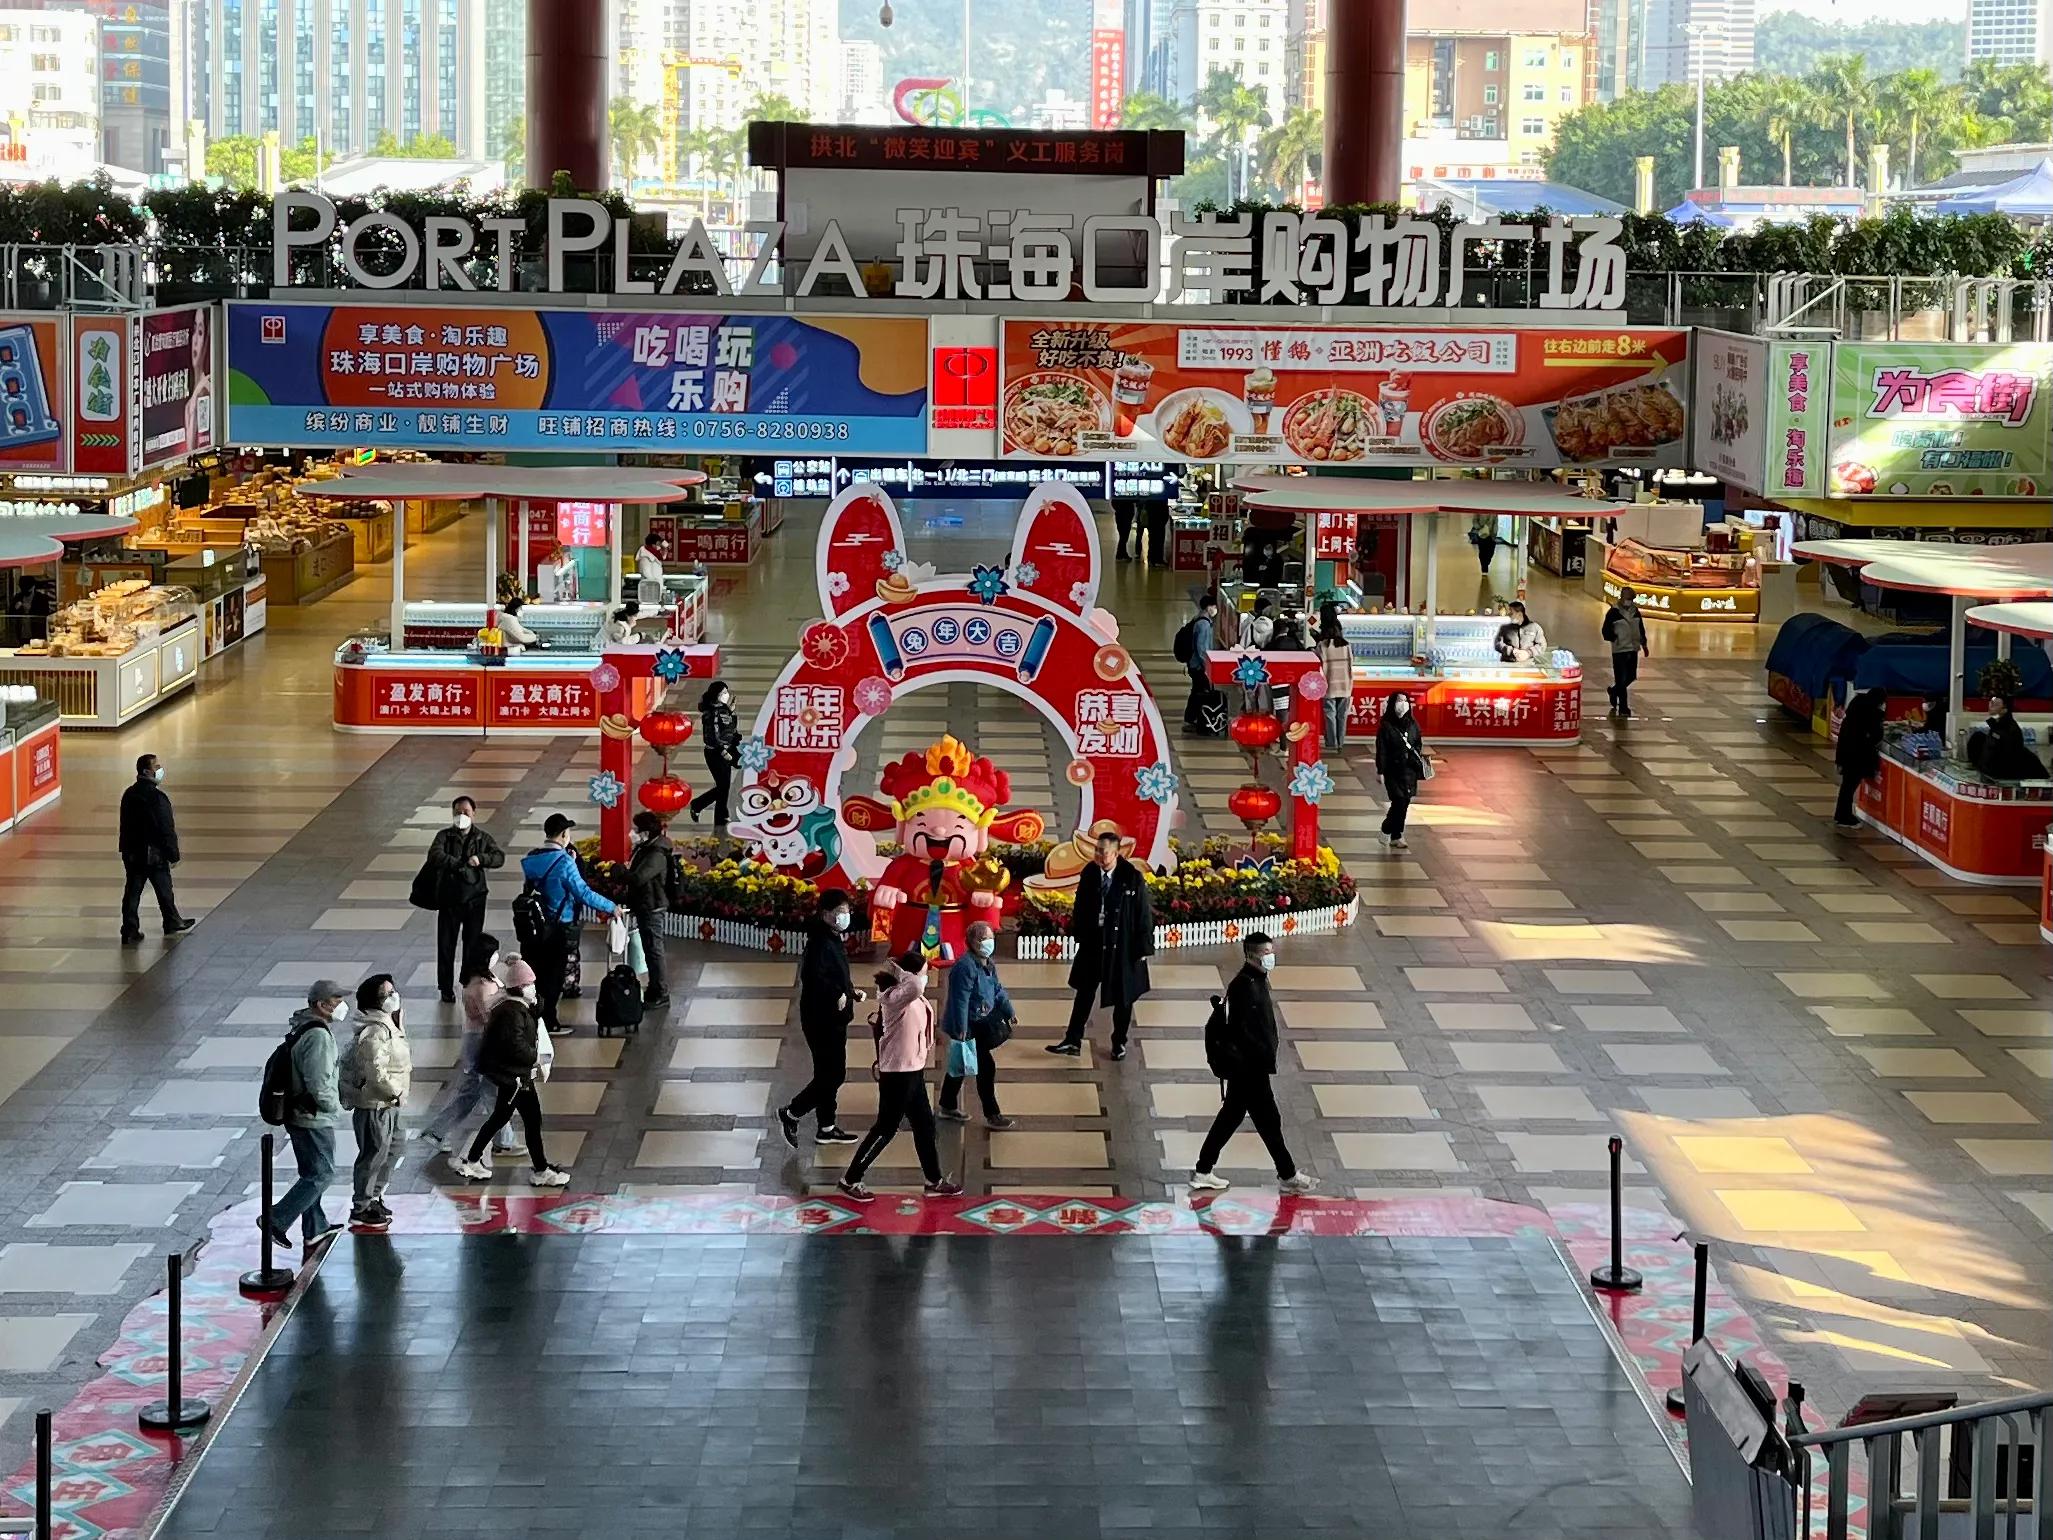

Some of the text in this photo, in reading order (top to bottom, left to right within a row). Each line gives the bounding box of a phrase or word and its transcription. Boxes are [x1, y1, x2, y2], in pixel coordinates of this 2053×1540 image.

[273, 191, 1627, 310] PORT PLAZA 珠海口岸购物广场
[358, 324, 508, 347] 享美食·淘乐趣
[633, 325, 754, 368] 吃喝玩
[1031, 329, 1111, 351] 全新升级
[1543, 334, 1647, 357] 往右边前走8米
[330, 350, 541, 379] 珠海口岸购物广场
[1036, 350, 1127, 370] 好吃不贵!
[1219, 346, 1254, 361] 1993
[368, 382, 497, 400] 一站式购物体验
[667, 369, 749, 413] 乐购
[1872, 370, 2034, 422] 为食街
[305, 411, 509, 435] 缤纷商业·靓铺生财
[1784, 352, 1809, 488] 享美食·淘乐趣
[1318, 512, 1357, 530] 澳门卡
[1317, 535, 1357, 554] 上网卡
[900, 617, 1023, 656] 兔年大吉
[389, 683, 464, 703] 盈发商行
[509, 684, 582, 704] 盈发商行
[779, 687, 840, 717] 新年
[1079, 694, 1141, 722] 恭喜
[1454, 697, 1532, 720] 弘兴商行
[778, 716, 840, 747] 快乐
[1079, 724, 1140, 754] 发财
